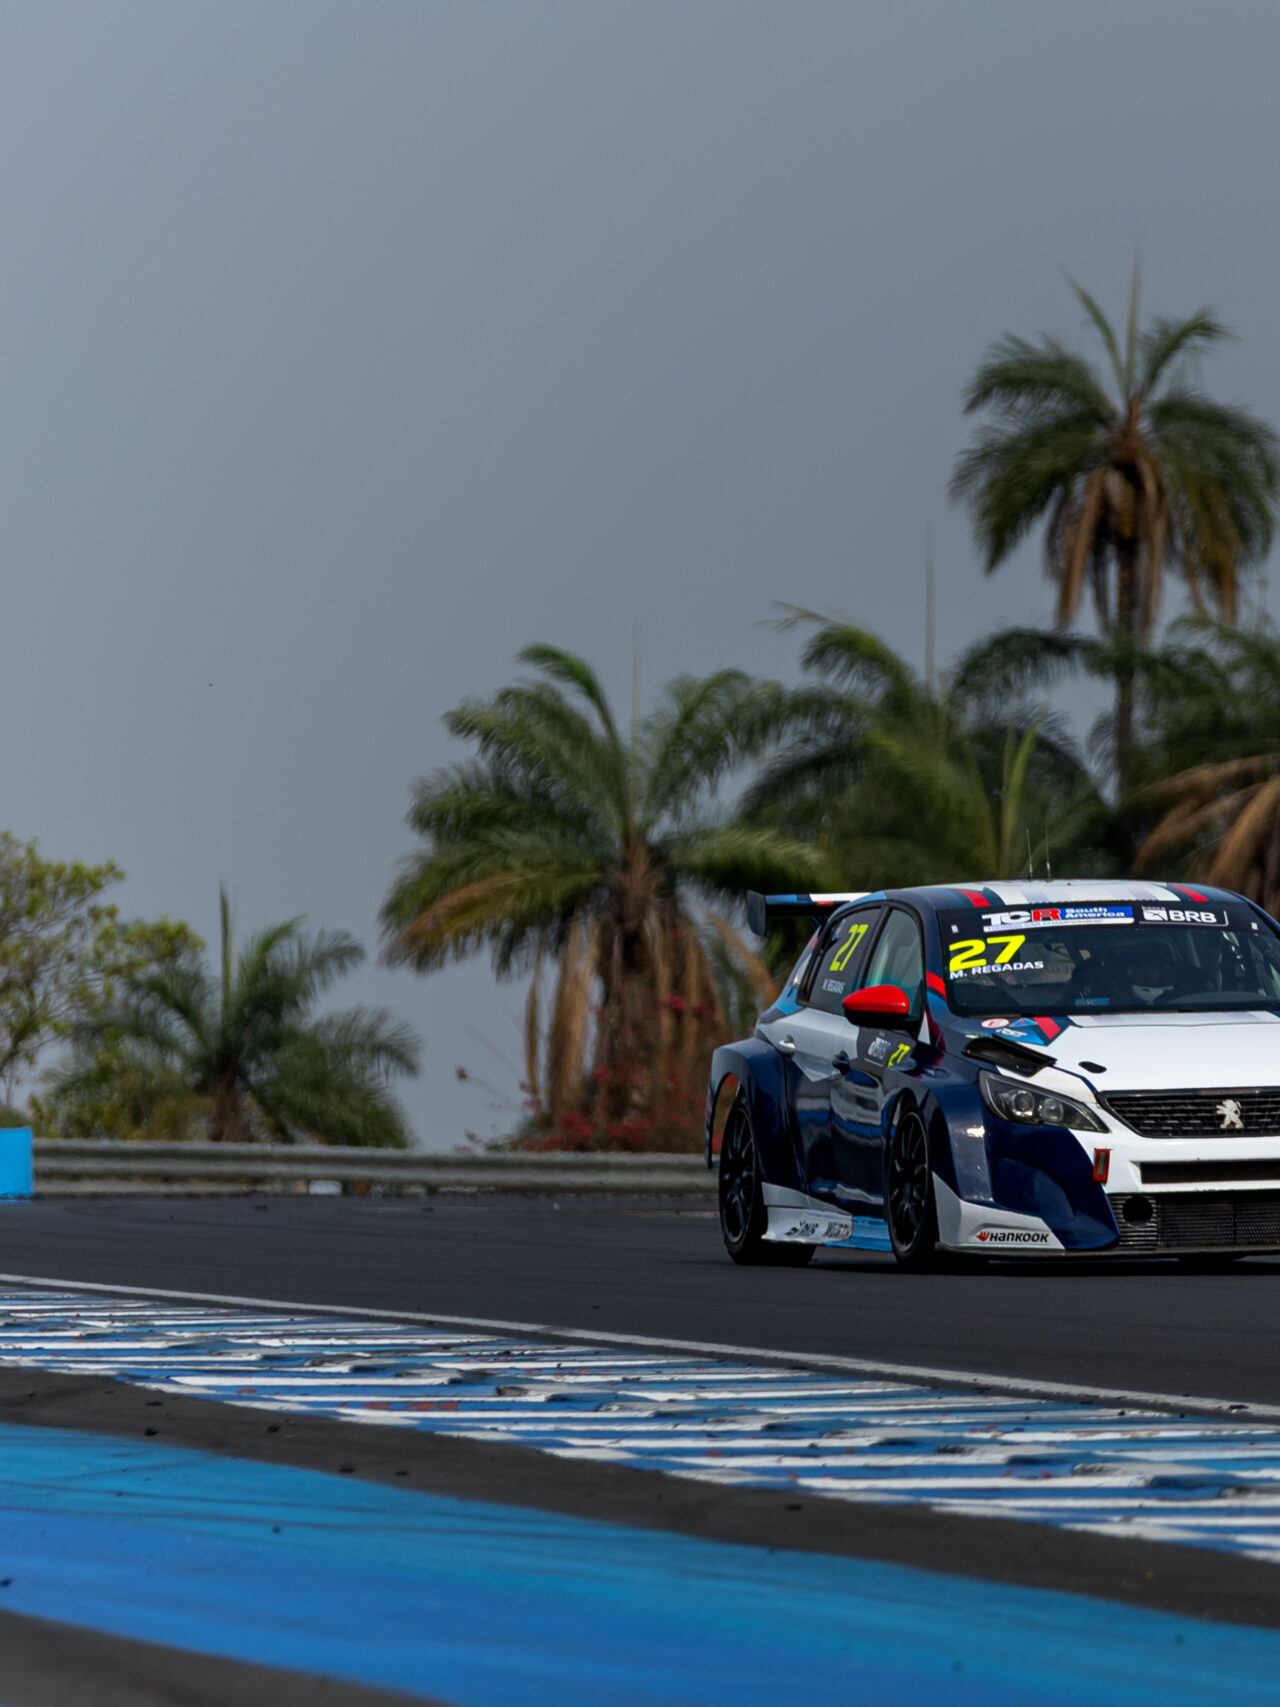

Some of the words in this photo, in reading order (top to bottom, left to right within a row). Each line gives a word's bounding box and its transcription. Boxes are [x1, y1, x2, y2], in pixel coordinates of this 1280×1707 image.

[982, 908, 1061, 926] TCR
[1168, 909, 1217, 923] BRB
[829, 924, 869, 971] 27
[949, 935, 1026, 972] 27
[949, 970, 968, 980] M.
[971, 961, 1044, 976] REGADAS
[888, 1043, 910, 1067] 27
